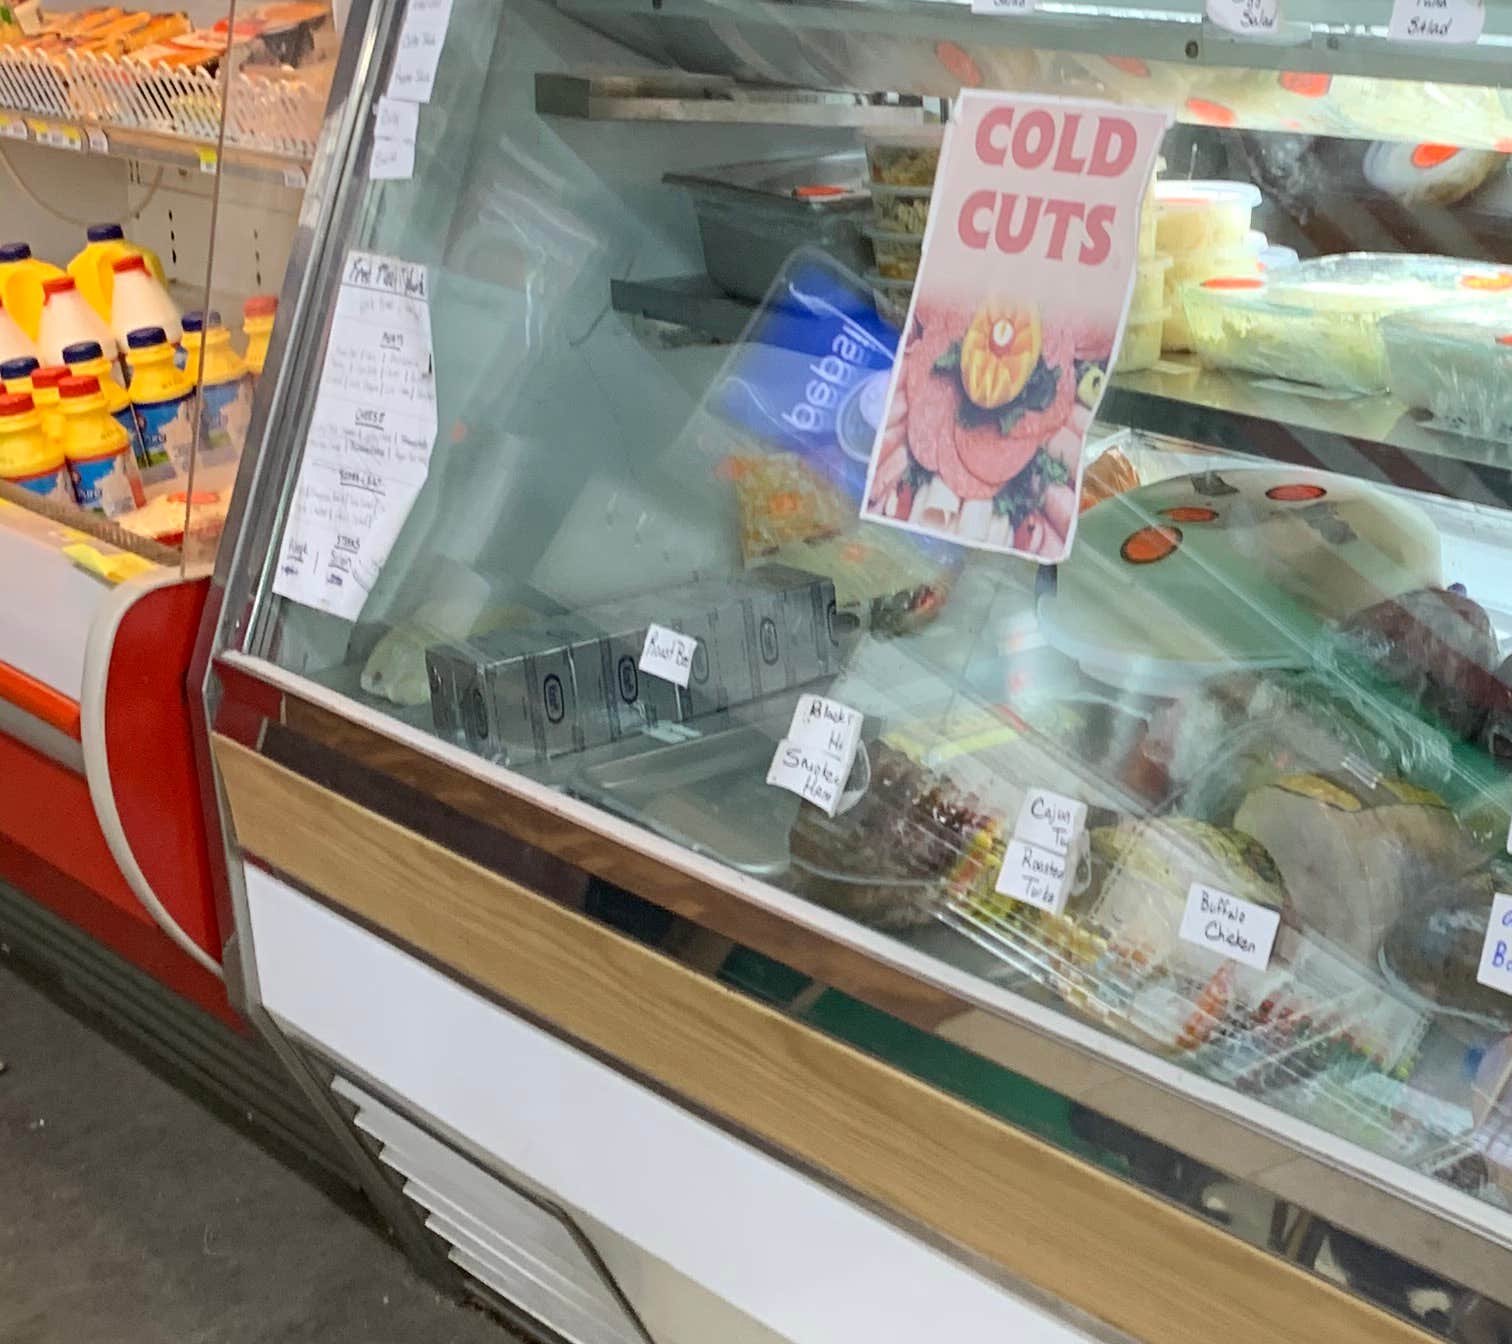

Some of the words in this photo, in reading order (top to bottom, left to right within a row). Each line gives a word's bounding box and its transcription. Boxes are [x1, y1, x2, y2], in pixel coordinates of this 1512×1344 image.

[974, 105, 1138, 179] COLD
[957, 189, 1116, 266] CUTS
[1031, 797, 1071, 825] Cajun
